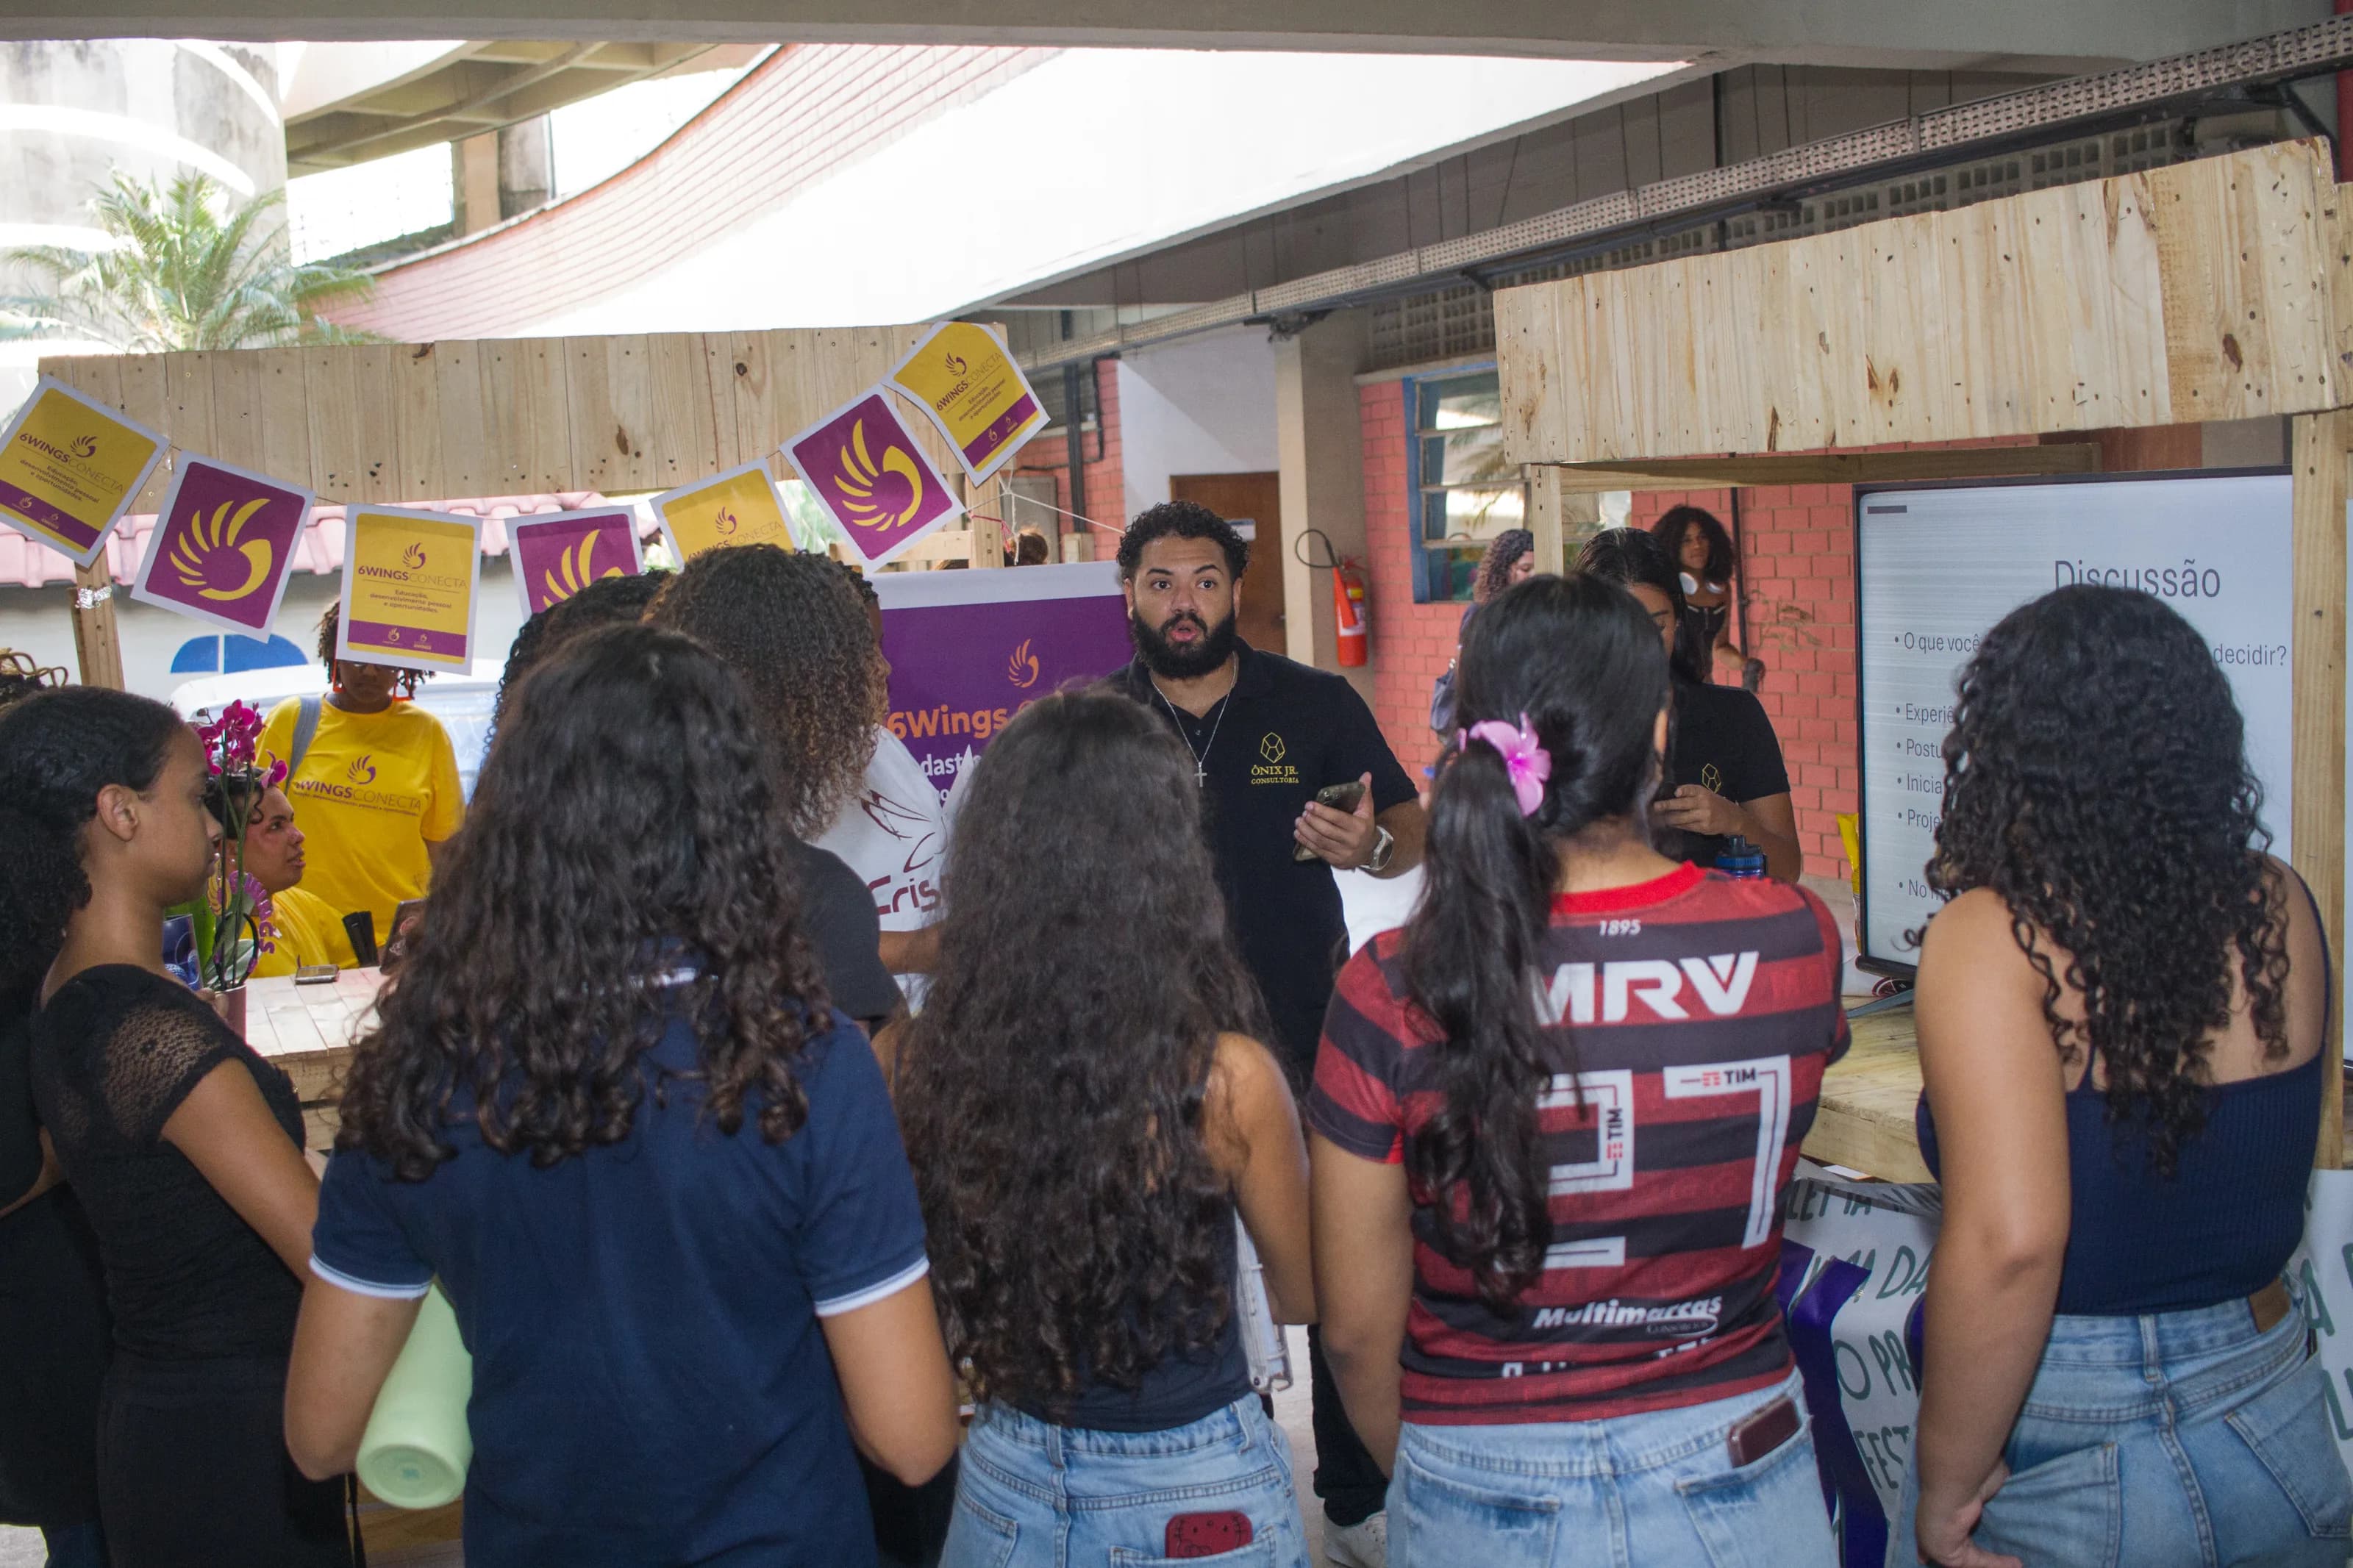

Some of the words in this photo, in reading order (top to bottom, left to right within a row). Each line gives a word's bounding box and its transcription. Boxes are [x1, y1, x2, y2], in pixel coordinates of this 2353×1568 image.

[1904, 631, 1915, 650] O
[1918, 636, 1944, 654] que
[1947, 634, 1980, 653] você
[2213, 644, 2288, 667] decidir?
[887, 704, 1009, 740] 6Wings
[1251, 765, 1283, 776] ÔNIX
[1251, 777, 1299, 785] CONSULTORIA
[1908, 878, 1927, 898] No
[1599, 919, 1641, 936] 1895
[1529, 951, 1760, 1026] MRV
[1724, 1067, 1757, 1085] TIM
[1607, 1108, 1624, 1141] TIM
[1532, 1296, 1723, 1330] Multimarcas
